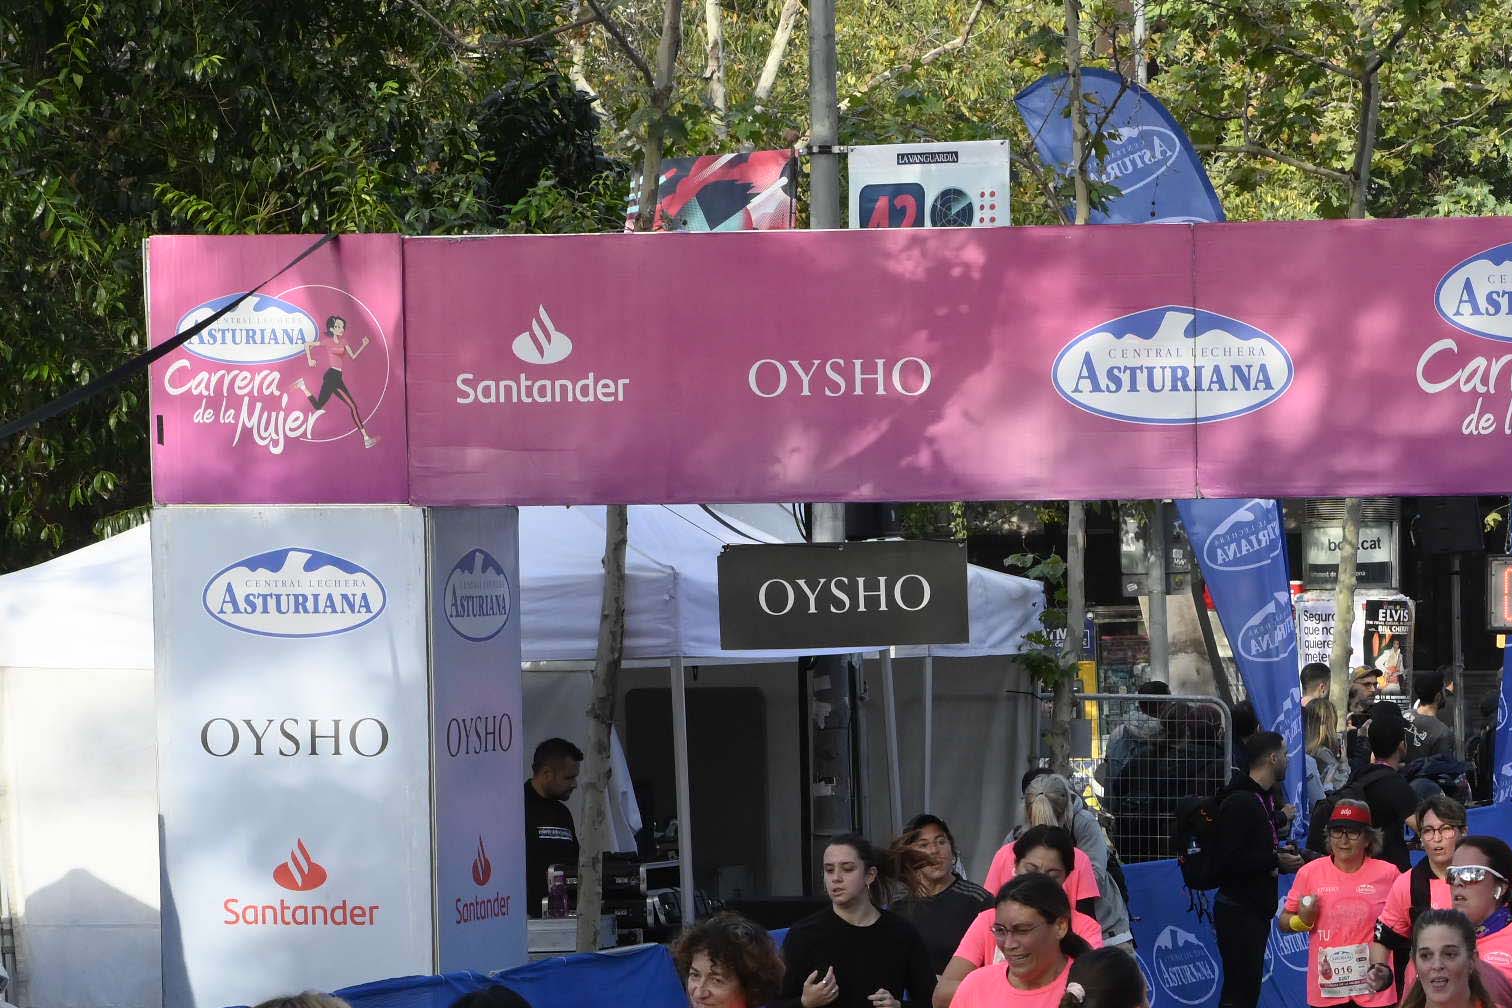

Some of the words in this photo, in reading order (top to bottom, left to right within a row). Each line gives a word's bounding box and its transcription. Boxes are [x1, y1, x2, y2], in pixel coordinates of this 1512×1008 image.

[188, 318, 306, 346] ASTURIANA
[1108, 347, 1182, 360] CENTRAL
[1190, 346, 1268, 359] LECHERA
[164, 359, 281, 396] Carrera
[748, 356, 932, 398] OYSHO
[1071, 349, 1275, 394] ASTURIANA
[456, 372, 629, 405] Santander
[193, 398, 216, 424] de
[219, 398, 236, 424] la
[232, 393, 326, 455] Mujer
[1462, 397, 1496, 436] de
[217, 581, 373, 617] ASTURIANA
[245, 580, 302, 589] CENTRAL
[308, 579, 368, 588] LECHERA
[759, 574, 931, 616] OYSHO
[450, 589, 508, 618] ASTURIANA
[1378, 609, 1409, 622] ELVIS
[1304, 626, 1319, 638] que
[1304, 638, 1333, 652] quiere
[200, 717, 390, 757] OYSHO
[446, 713, 513, 757] OYSHO
[223, 898, 380, 926] Santander
[455, 892, 511, 923] Santander
[1319, 930, 1330, 941] TU
[1334, 965, 1353, 975] 016
